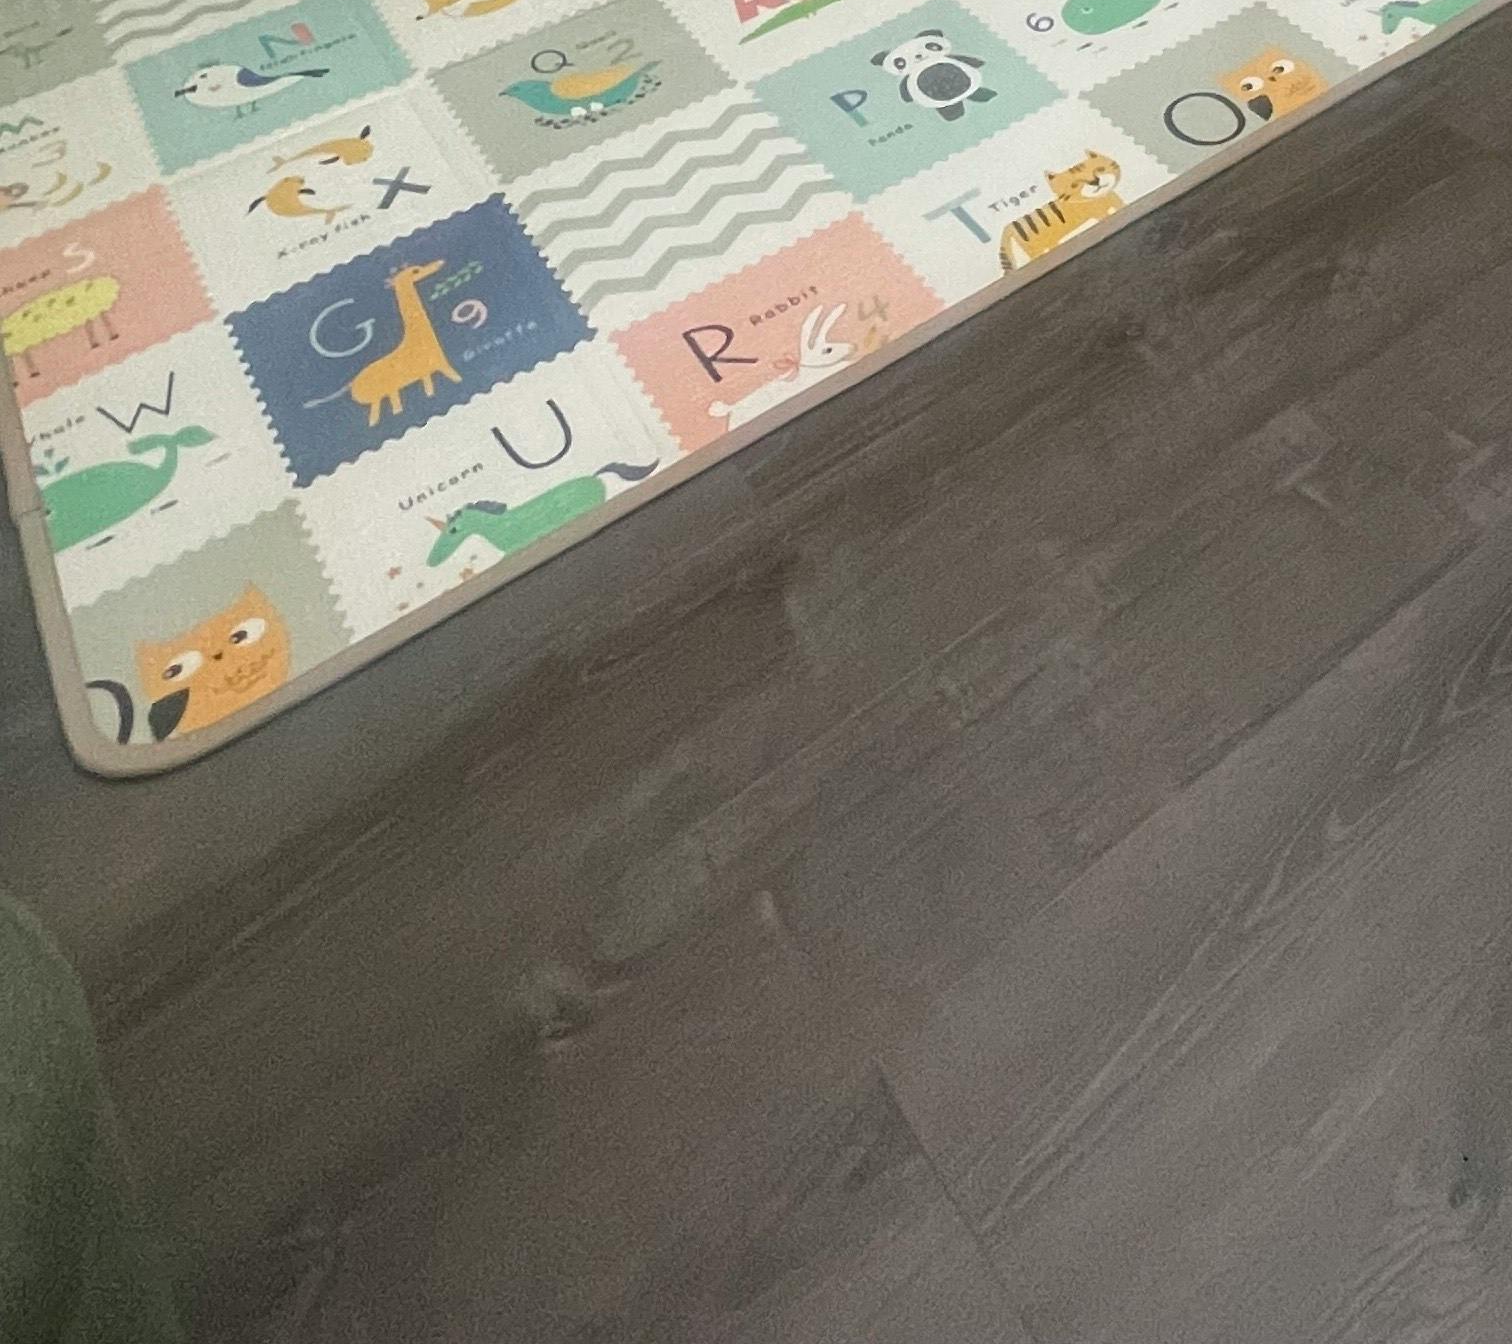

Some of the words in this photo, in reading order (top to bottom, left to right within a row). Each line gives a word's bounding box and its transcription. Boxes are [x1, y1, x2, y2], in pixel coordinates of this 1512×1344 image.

[1026, 12, 1055, 33] 6
[531, 49, 575, 74] Q
[607, 38, 643, 66] 2
[829, 89, 868, 128] P
[1162, 92, 1247, 147] O
[372, 166, 432, 210] X
[987, 184, 1039, 213] Tiger
[920, 187, 992, 245] T
[62, 242, 97, 274] S
[449, 298, 489, 330] 9
[749, 284, 820, 327] Rabbit
[857, 295, 890, 323] 4
[309, 297, 376, 359] G
[681, 323, 759, 384] R
[95, 370, 175, 434] W
[491, 398, 573, 470] U
[397, 461, 484, 511] Unicorn
